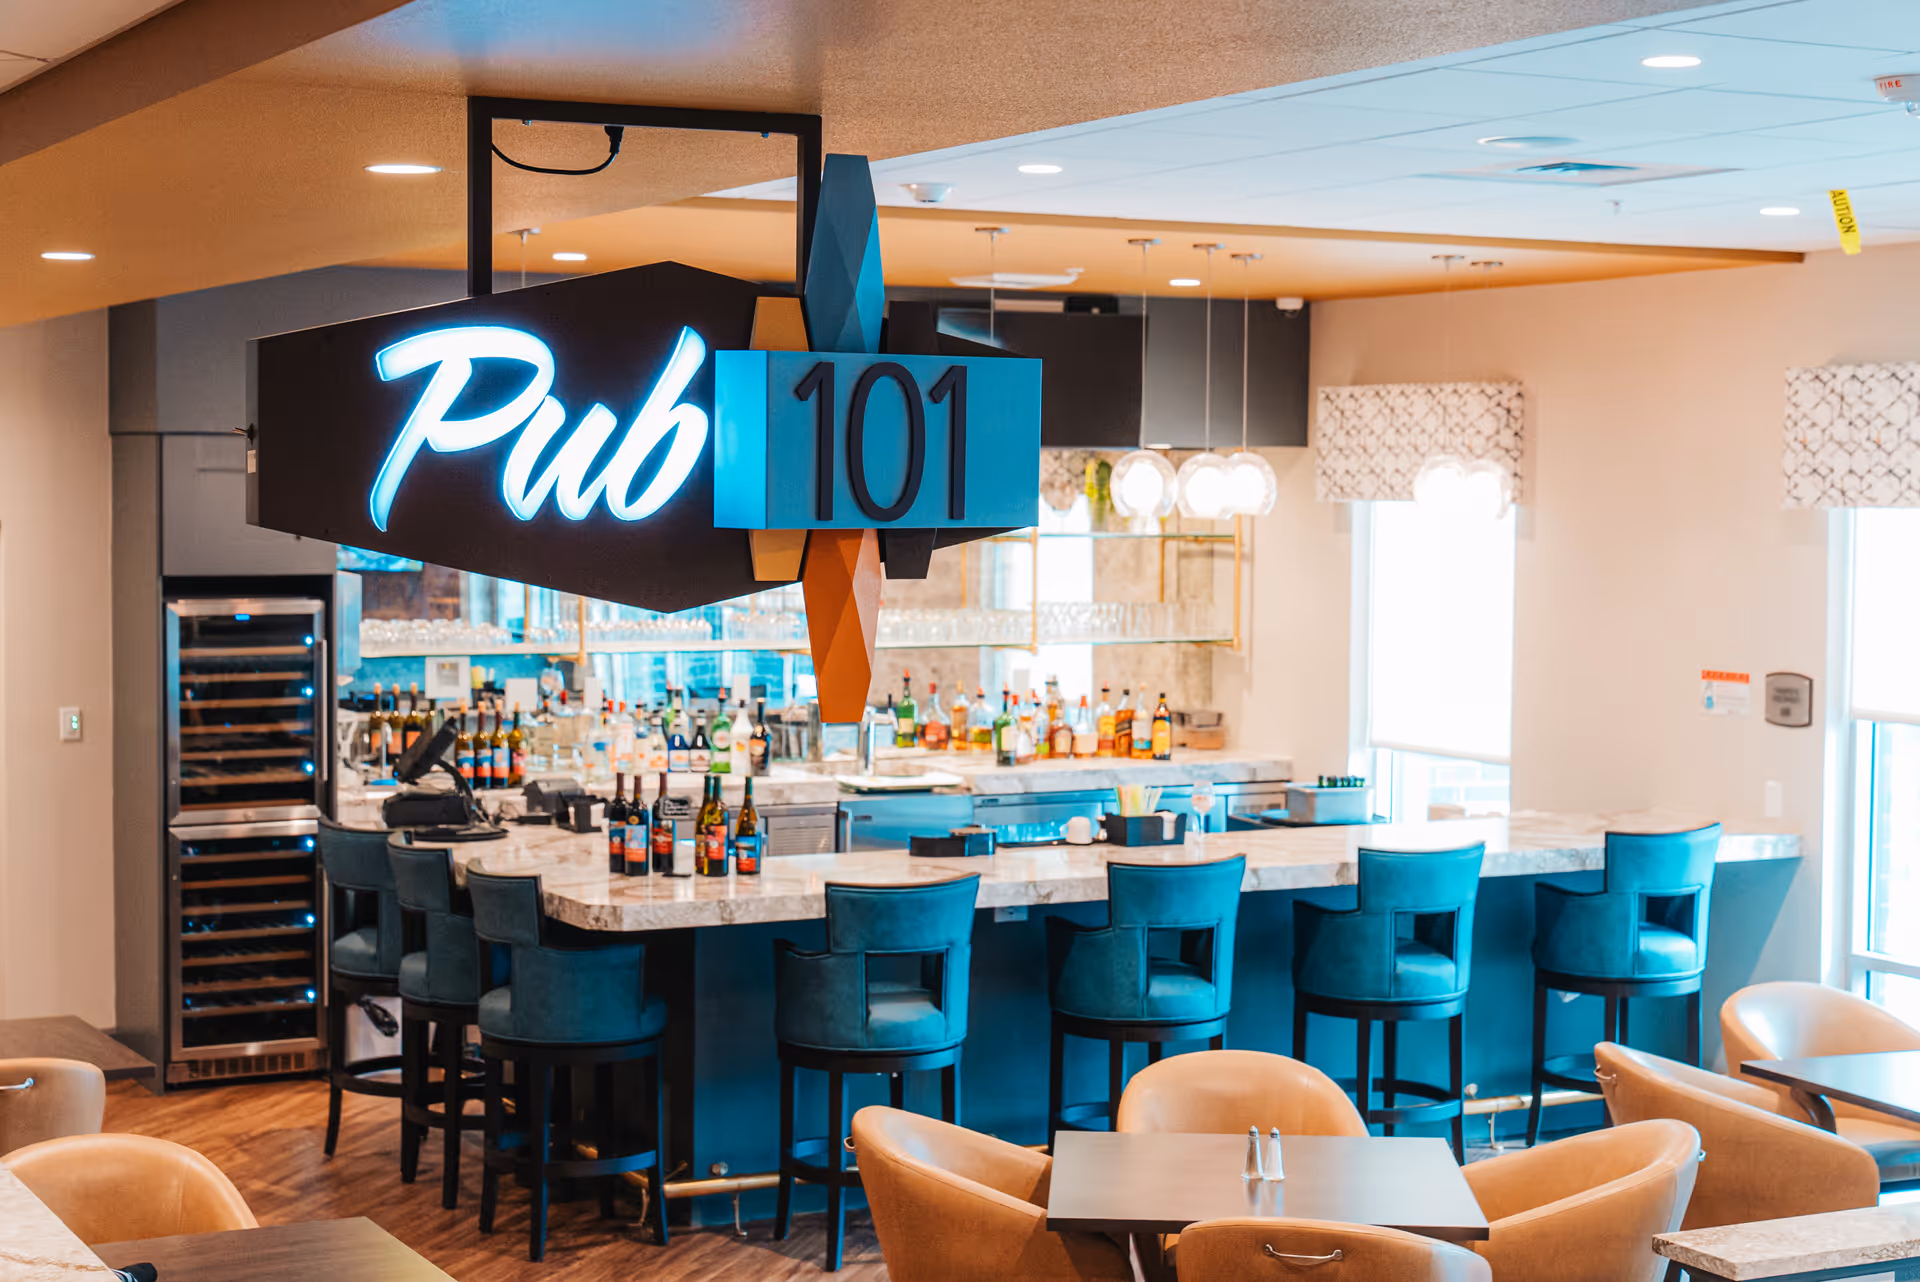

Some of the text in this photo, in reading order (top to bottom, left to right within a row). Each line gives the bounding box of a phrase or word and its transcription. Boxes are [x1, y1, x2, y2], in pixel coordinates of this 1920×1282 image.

[1879, 80, 1902, 90] FIRE
[370, 325, 709, 533] Pub
[794, 361, 968, 522] 101
